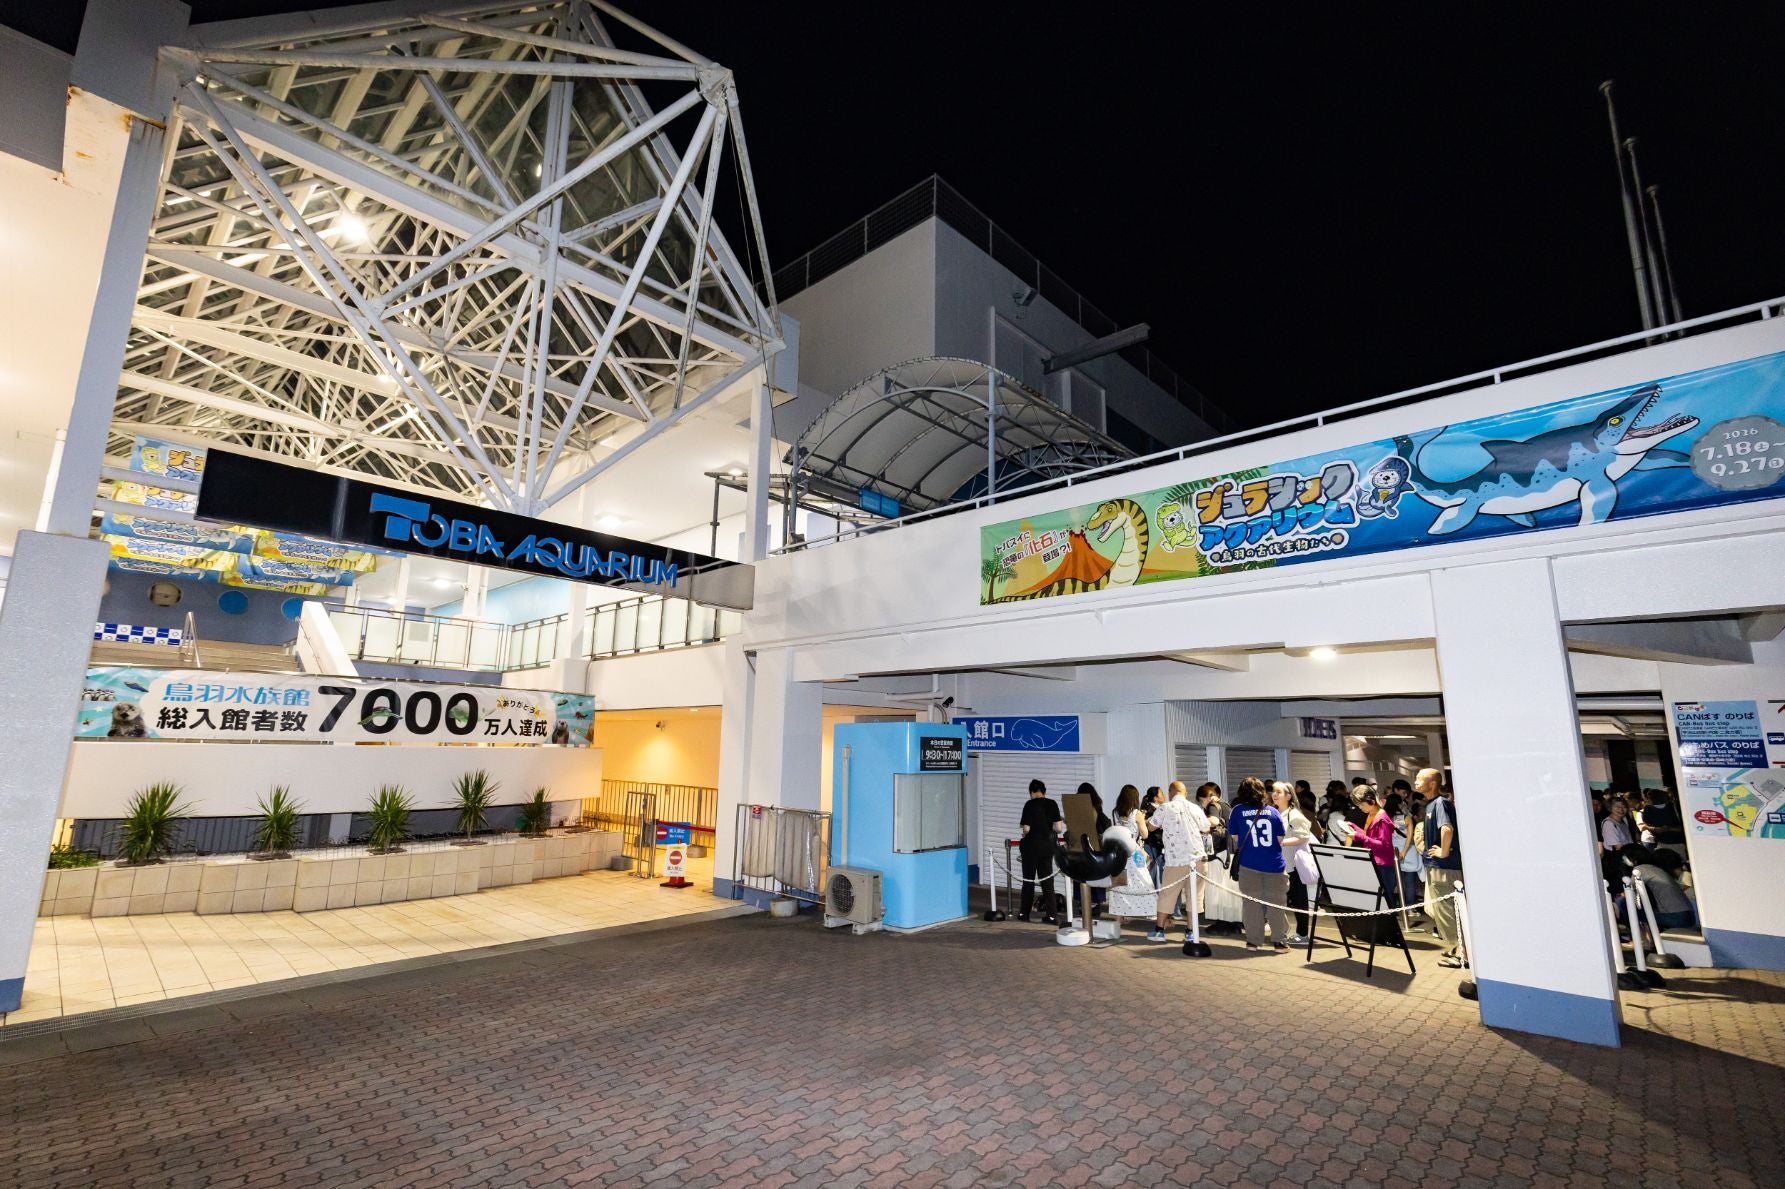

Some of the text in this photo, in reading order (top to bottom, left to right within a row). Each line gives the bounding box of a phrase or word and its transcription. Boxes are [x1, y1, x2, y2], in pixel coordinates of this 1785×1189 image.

[1723, 428, 1758, 440] 2026
[1196, 463, 1355, 524] ジュラシック
[1198, 500, 1355, 551] アクアリウム
[370, 492, 678, 588] TOBA AQUARIUM
[995, 531, 1030, 553] トバスイに
[1219, 536, 1332, 563] 鳥羽の古代生物たち
[162, 682, 311, 707] 鳥羽水族館
[156, 685, 548, 738] 総入館者数 7000 万人達成
[1677, 712, 1755, 721] CANばす のりば
[961, 720, 1005, 739] 館口
[967, 739, 997, 747] Entrance
[1732, 741, 1760, 749] のりば
[1245, 818, 1273, 848] 13
